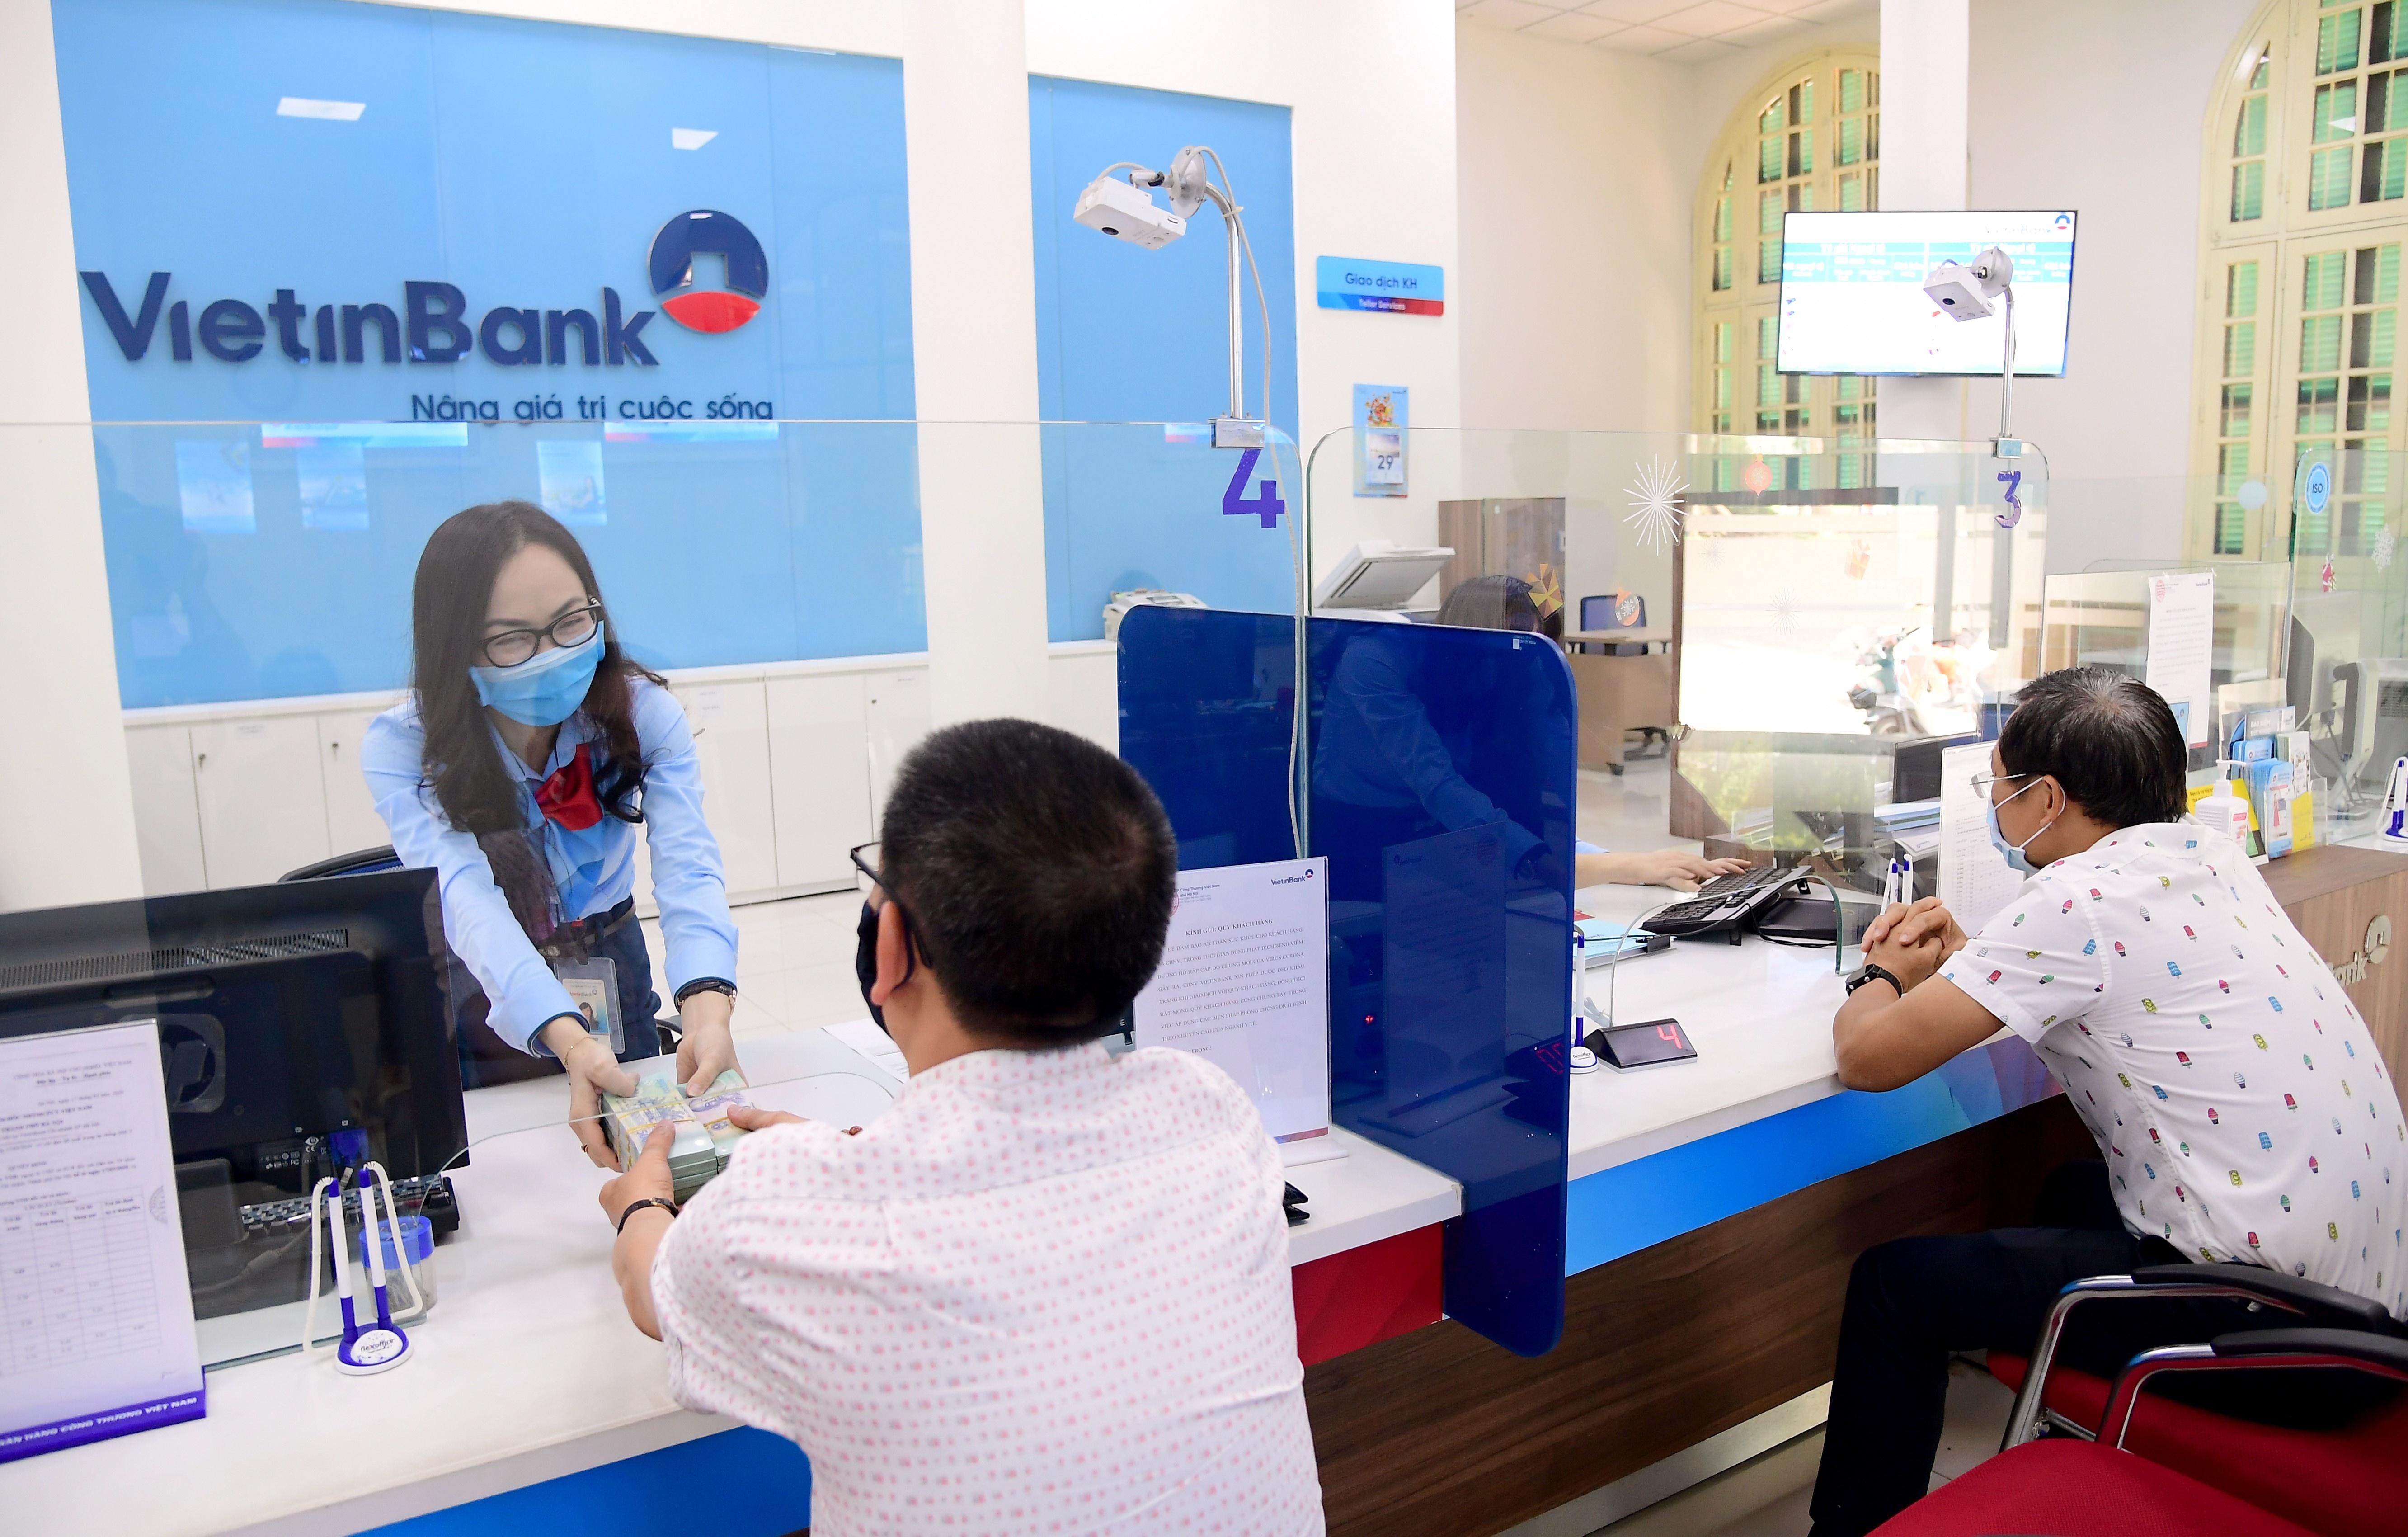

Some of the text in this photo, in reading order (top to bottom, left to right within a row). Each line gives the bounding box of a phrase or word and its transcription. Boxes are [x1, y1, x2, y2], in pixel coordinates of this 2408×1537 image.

[1345, 273, 1417, 290] Giao dịch KH
[80, 271, 659, 367] VietinBank
[412, 395, 499, 424] Nâng
[515, 393, 563, 423] giá
[706, 392, 773, 420] sống
[1378, 455, 1393, 470] 29
[1222, 449, 1285, 529] 4
[2312, 483, 2323, 494] ISO
[1994, 470, 2022, 529] 3
[1270, 875, 1306, 886] VietinBank
[1656, 1025, 1682, 1050] 4
[171, 1397, 197, 1409] NAM
